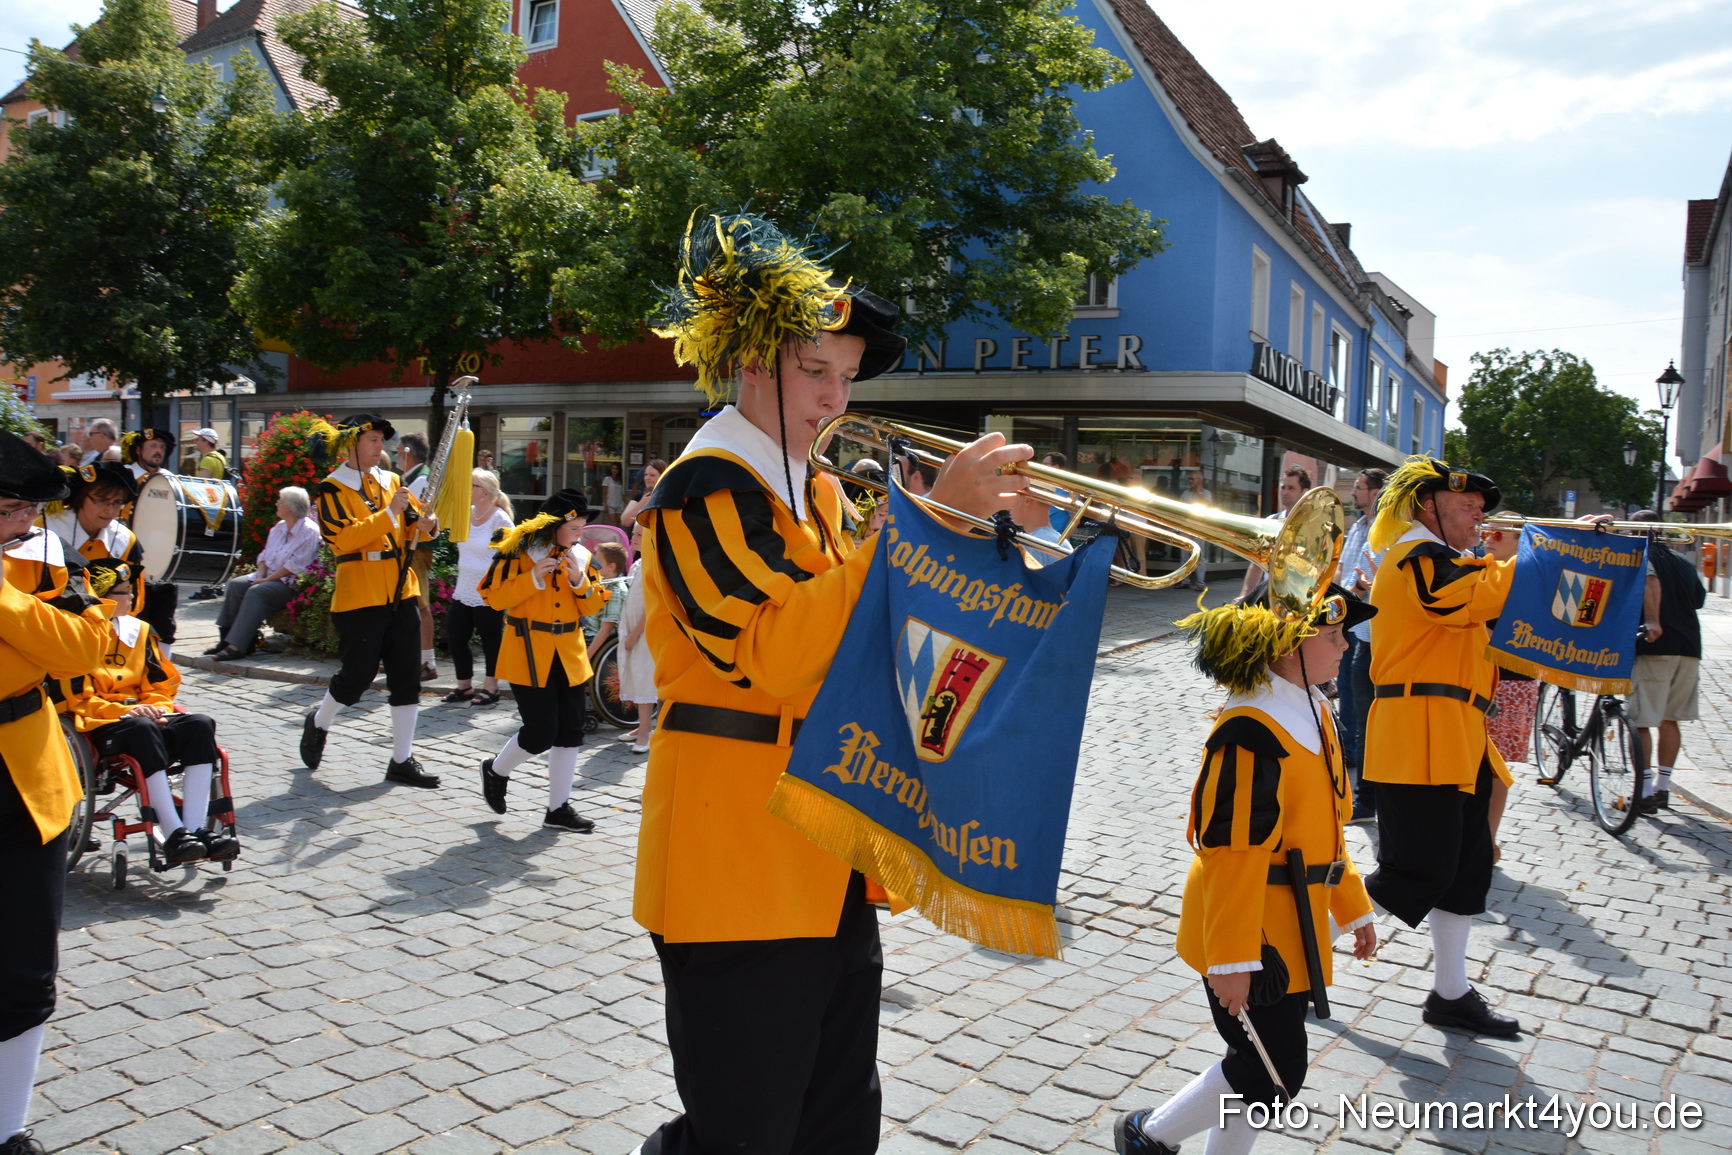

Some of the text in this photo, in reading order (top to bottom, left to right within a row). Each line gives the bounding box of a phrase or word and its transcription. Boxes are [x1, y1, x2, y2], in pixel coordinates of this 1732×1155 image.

[416, 353, 482, 375] TKO
[974, 334, 1143, 370] PETER
[1259, 343, 1339, 415] ANTON PETE
